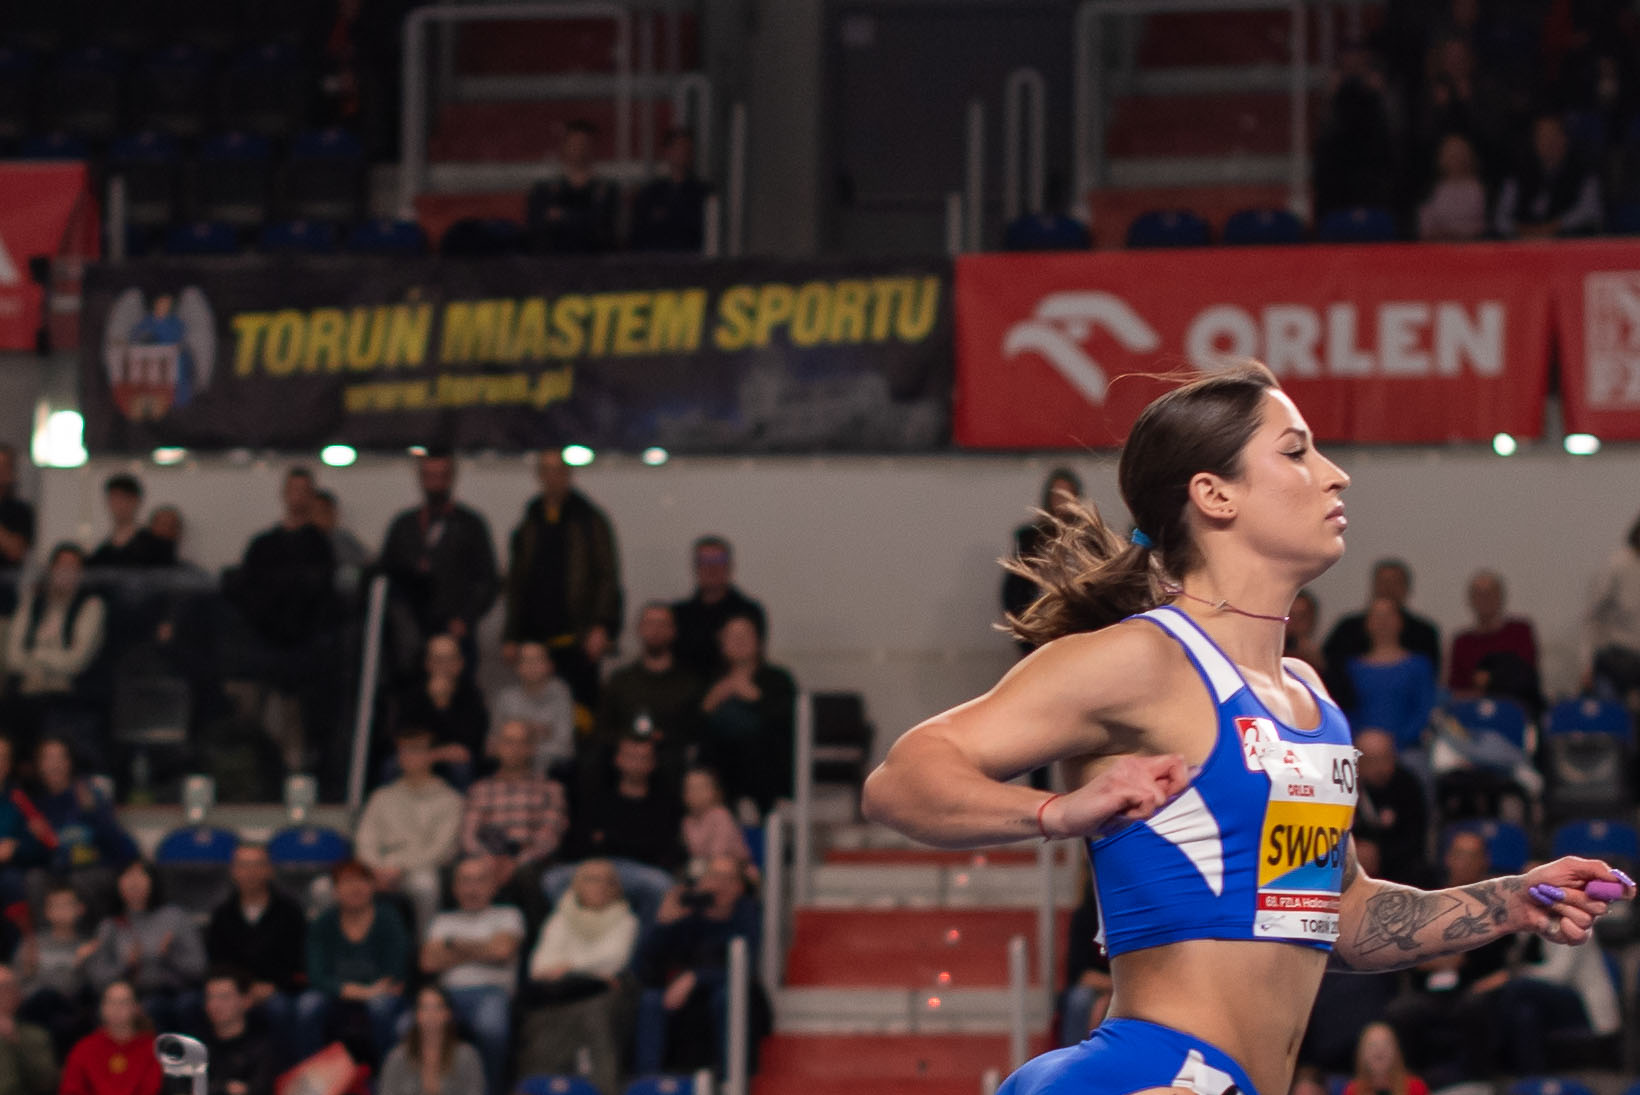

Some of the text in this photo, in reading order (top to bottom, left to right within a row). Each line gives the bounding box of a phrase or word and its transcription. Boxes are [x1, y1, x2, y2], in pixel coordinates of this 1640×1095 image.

[232, 275, 941, 378] TORUŃ MIASTEM SPORTU
[1185, 300, 1506, 381] ORLEN
[1267, 824, 1348, 869] SWOB
